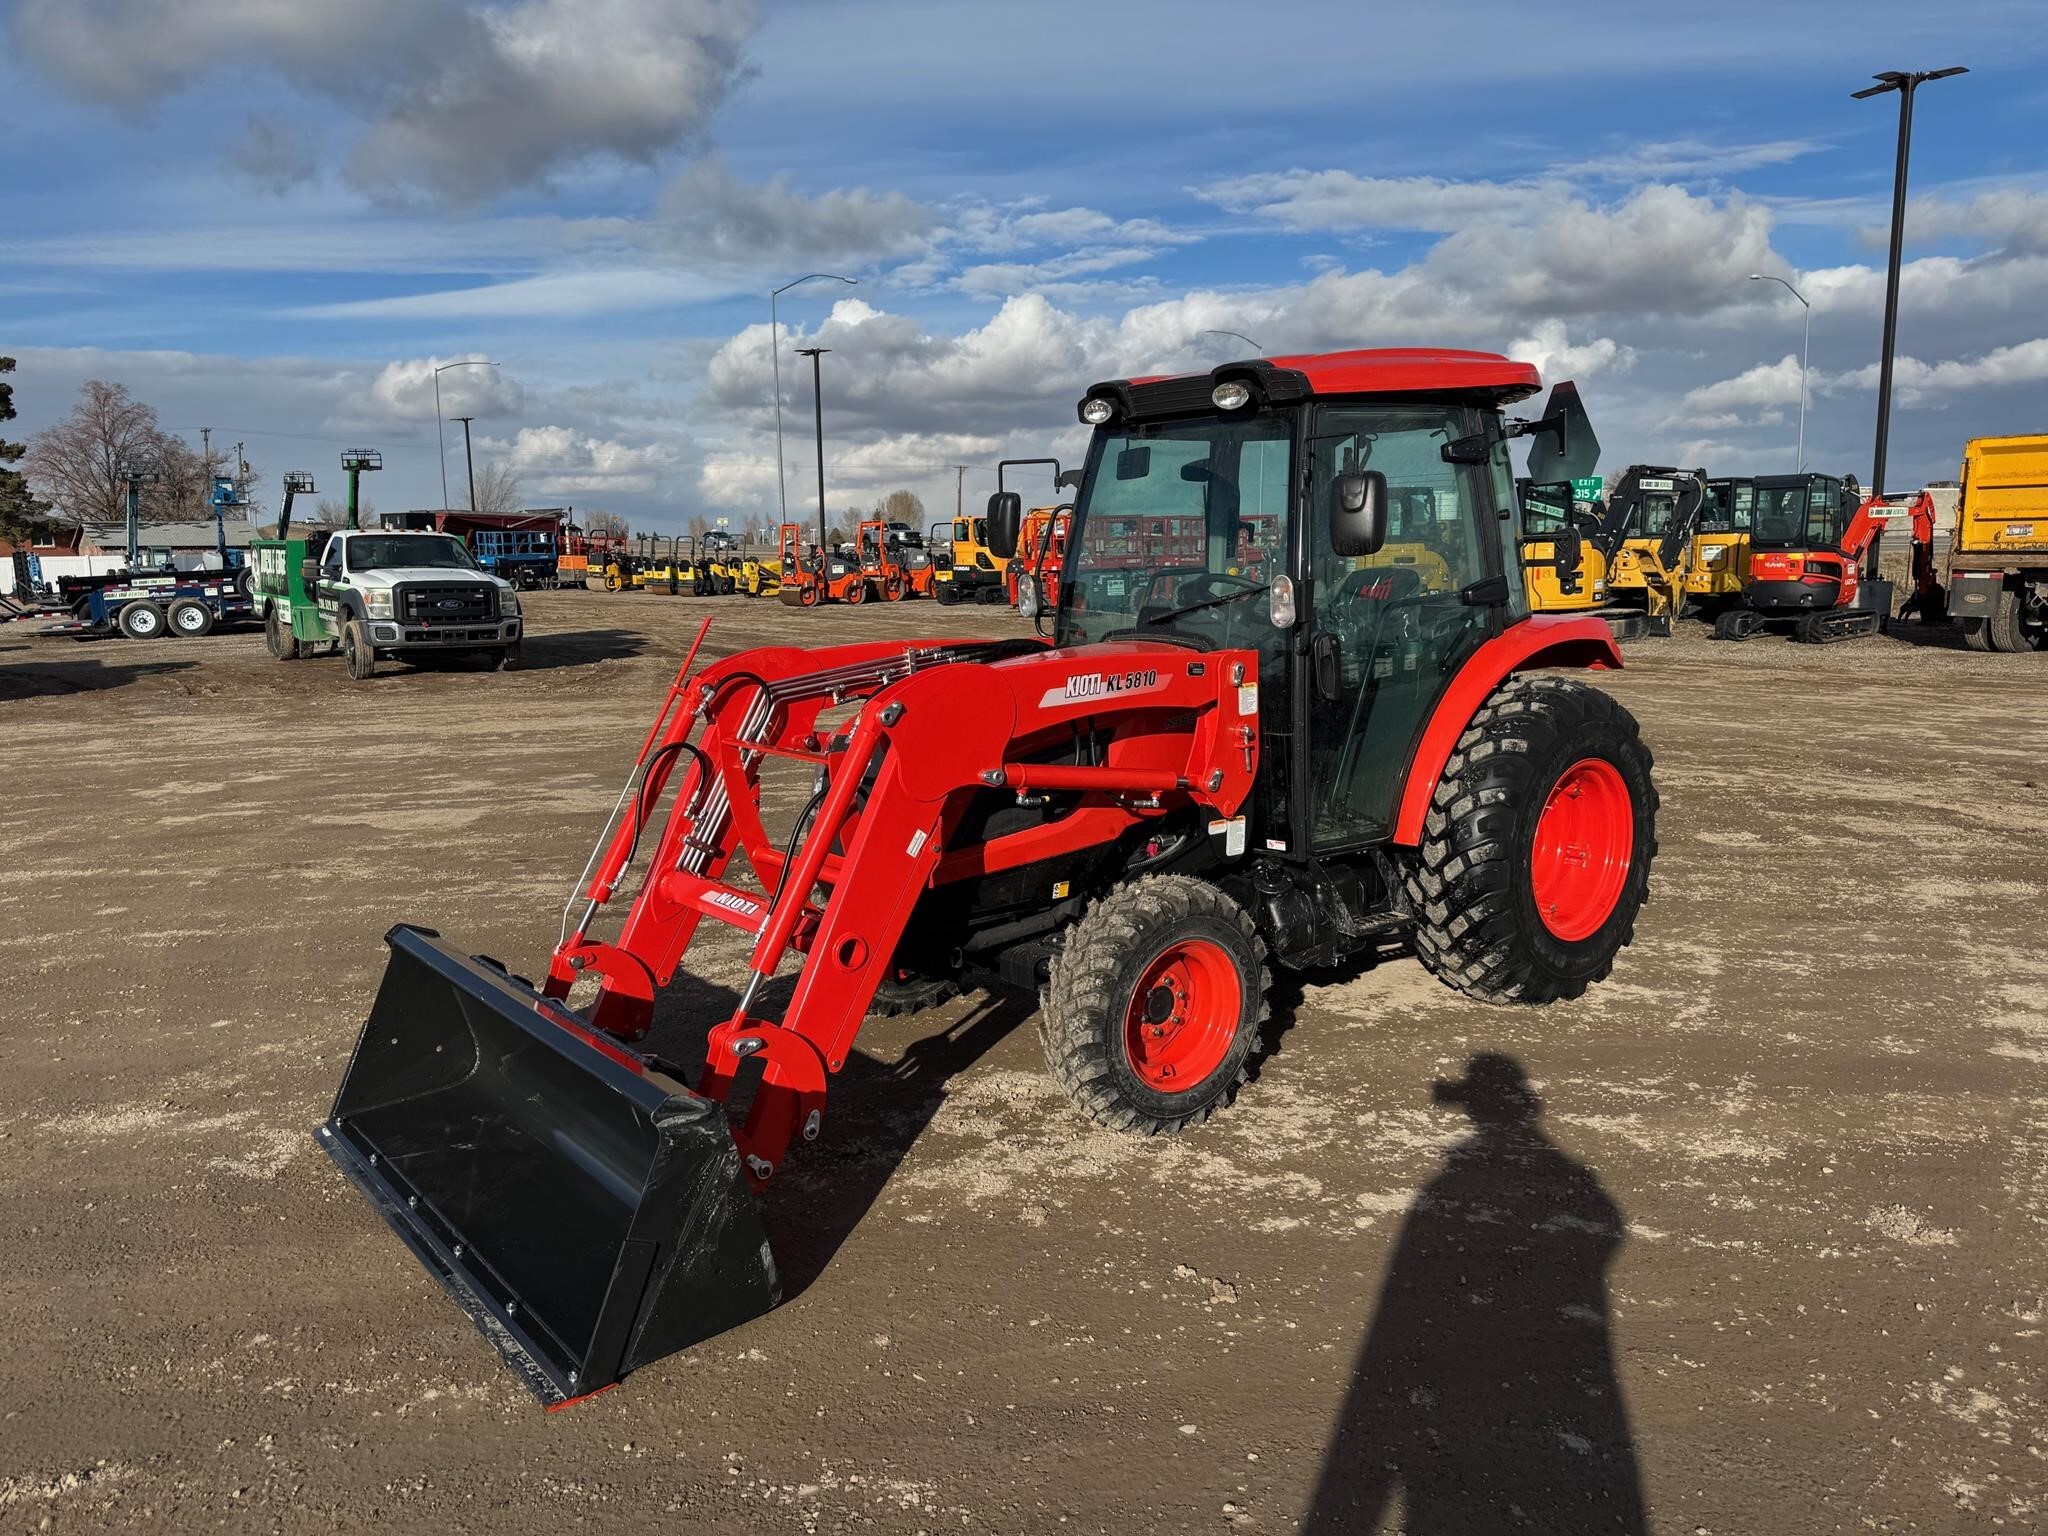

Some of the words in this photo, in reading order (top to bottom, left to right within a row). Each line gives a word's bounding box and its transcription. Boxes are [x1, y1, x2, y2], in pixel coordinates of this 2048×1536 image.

[1575, 489, 1590, 499] 315
[1065, 673, 1102, 698] KIOTI
[714, 892, 760, 915] KIOTI
